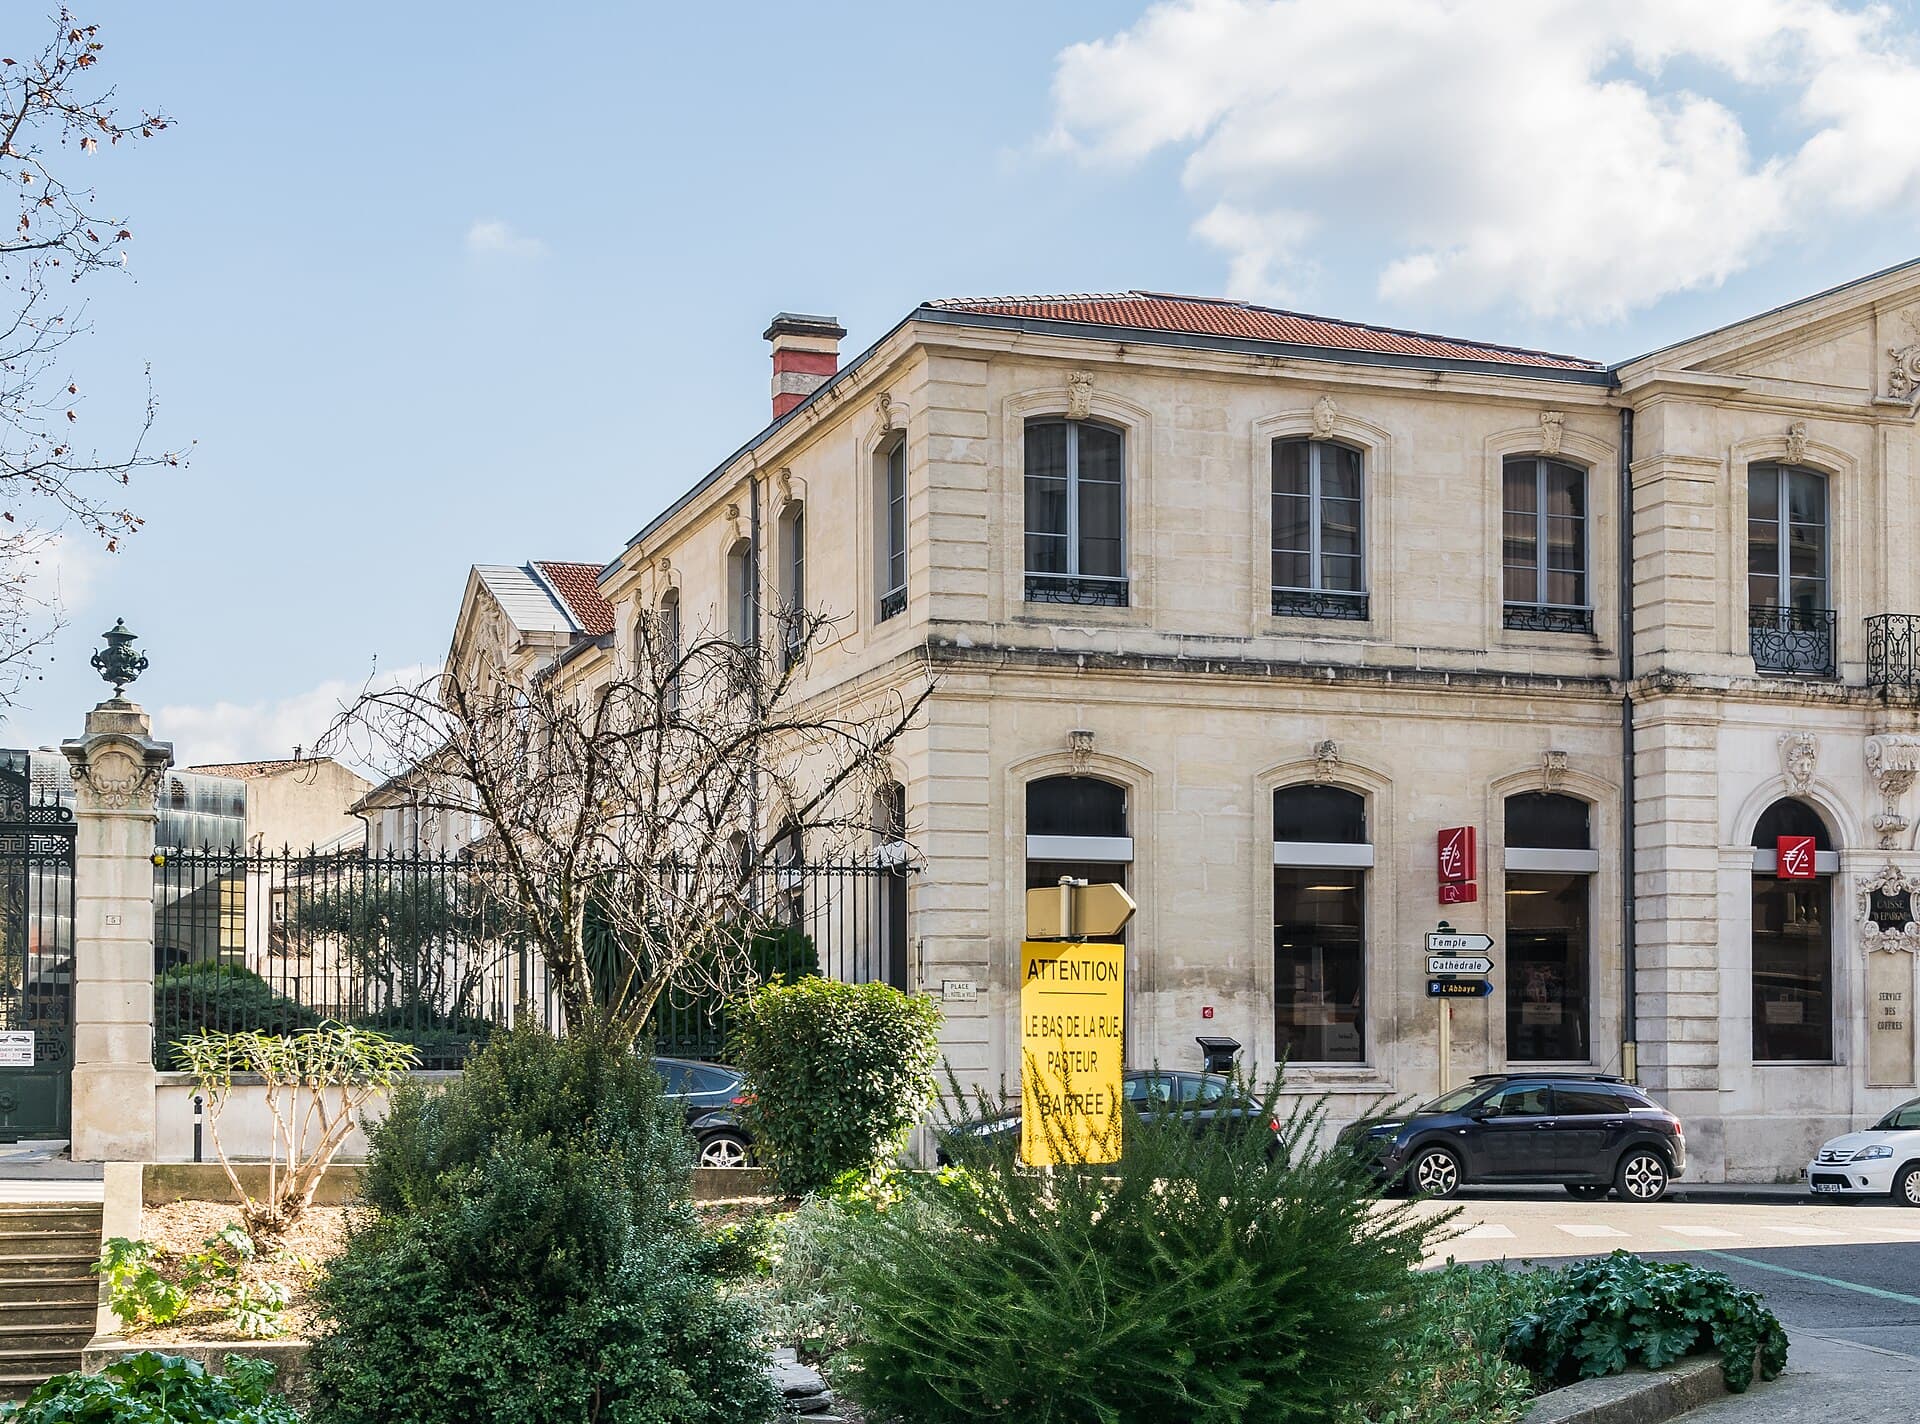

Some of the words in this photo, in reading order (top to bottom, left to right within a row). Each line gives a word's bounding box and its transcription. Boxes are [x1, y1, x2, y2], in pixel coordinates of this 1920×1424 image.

[1432, 937, 1467, 949] Temple
[1027, 958, 1118, 981] ATTENTION
[1432, 960, 1482, 970] Cathédrale
[1432, 984, 1439, 992] P
[1442, 984, 1476, 994] L'Abbaye
[1025, 1015, 1038, 1037] LE
[1041, 1015, 1063, 1038] BAS
[1066, 1015, 1080, 1038] DE
[1083, 1015, 1097, 1038] LA
[1098, 1016, 1119, 1038] RUE
[1047, 1050, 1098, 1073] PASTEUR
[1040, 1087, 1104, 1116] BARRÉE
